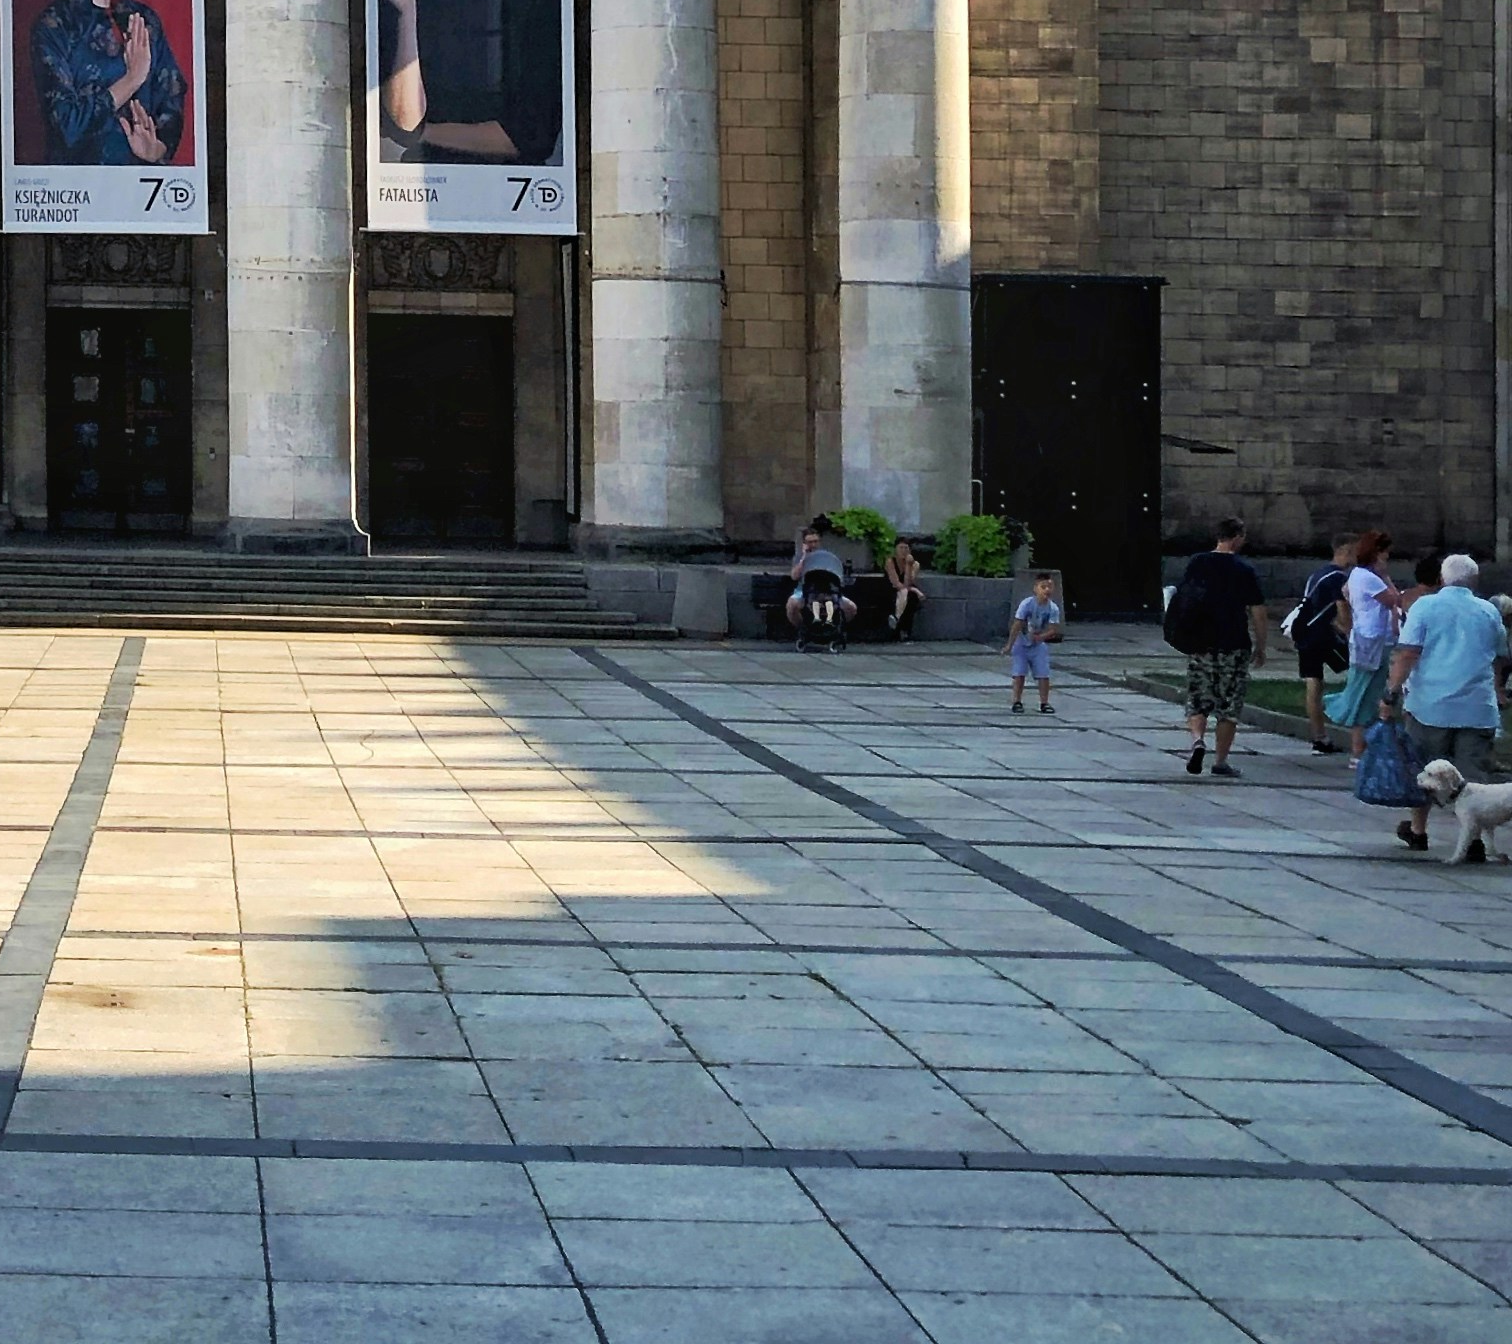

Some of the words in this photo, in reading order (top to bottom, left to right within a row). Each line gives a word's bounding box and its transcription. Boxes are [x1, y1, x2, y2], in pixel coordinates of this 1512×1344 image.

[15, 188, 90, 207] KSIĘŻNICZKA
[379, 188, 438, 202] FATALISTA
[15, 209, 79, 222] TURANDOT
